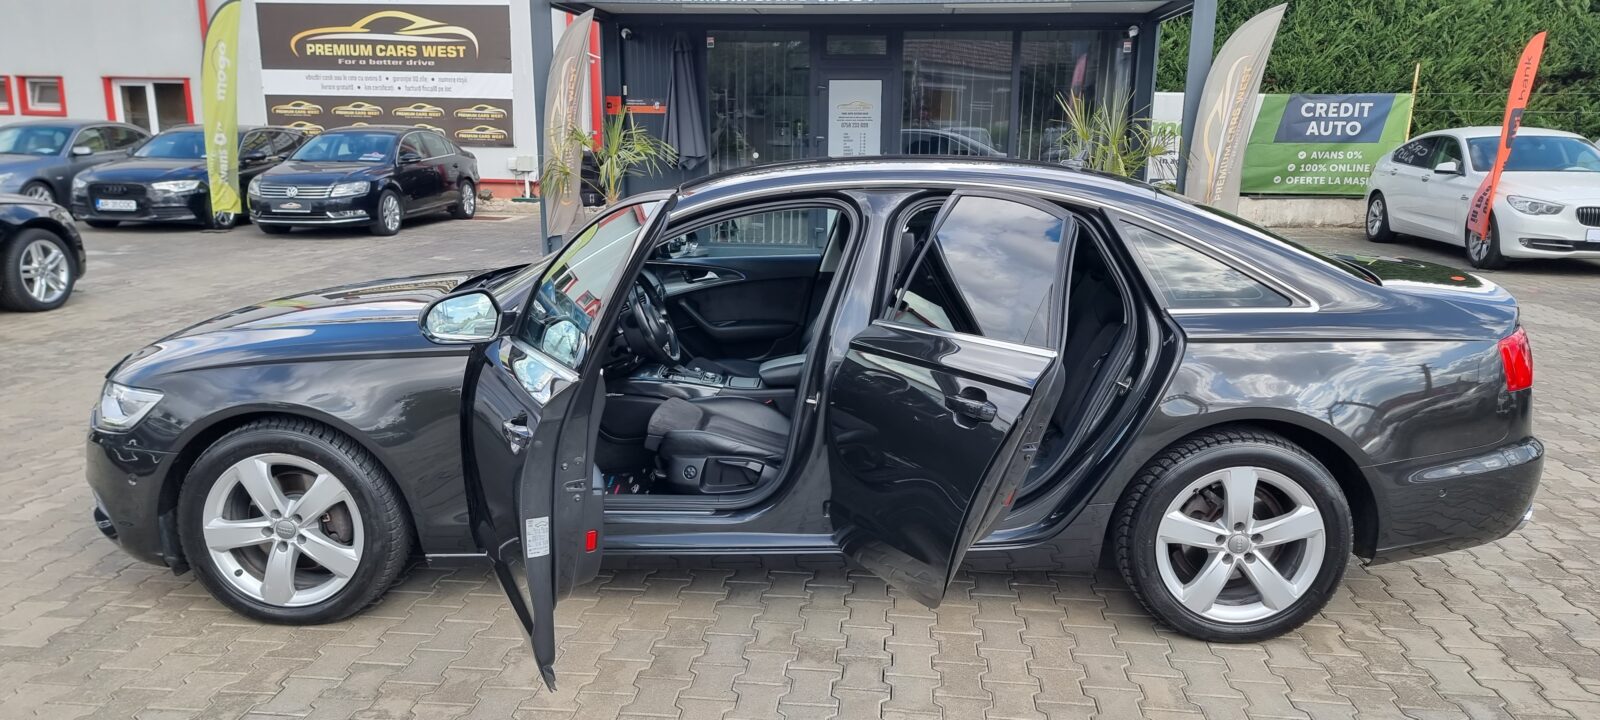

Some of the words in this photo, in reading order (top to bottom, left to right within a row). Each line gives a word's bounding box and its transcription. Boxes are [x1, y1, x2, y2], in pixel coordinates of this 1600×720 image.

[306, 43, 372, 57] PREMIUM
[376, 44, 418, 57] CARS
[422, 45, 467, 58] WEST
[370, 58, 403, 66] better
[216, 41, 230, 101] mogo
[1300, 102, 1374, 118] CREDIT
[1214, 145, 1232, 201] PREMIUM
[1227, 107, 1242, 143] CARS
[1236, 64, 1253, 105] WEST
[1305, 120, 1362, 136] AUTO
[1310, 151, 1344, 159] AVANS
[1346, 151, 1362, 159] 0%
[1300, 164, 1327, 172] 100%
[1330, 164, 1370, 172] ONLINE
[1286, 176, 1326, 185] OFERTE
[1328, 176, 1341, 185] LA
